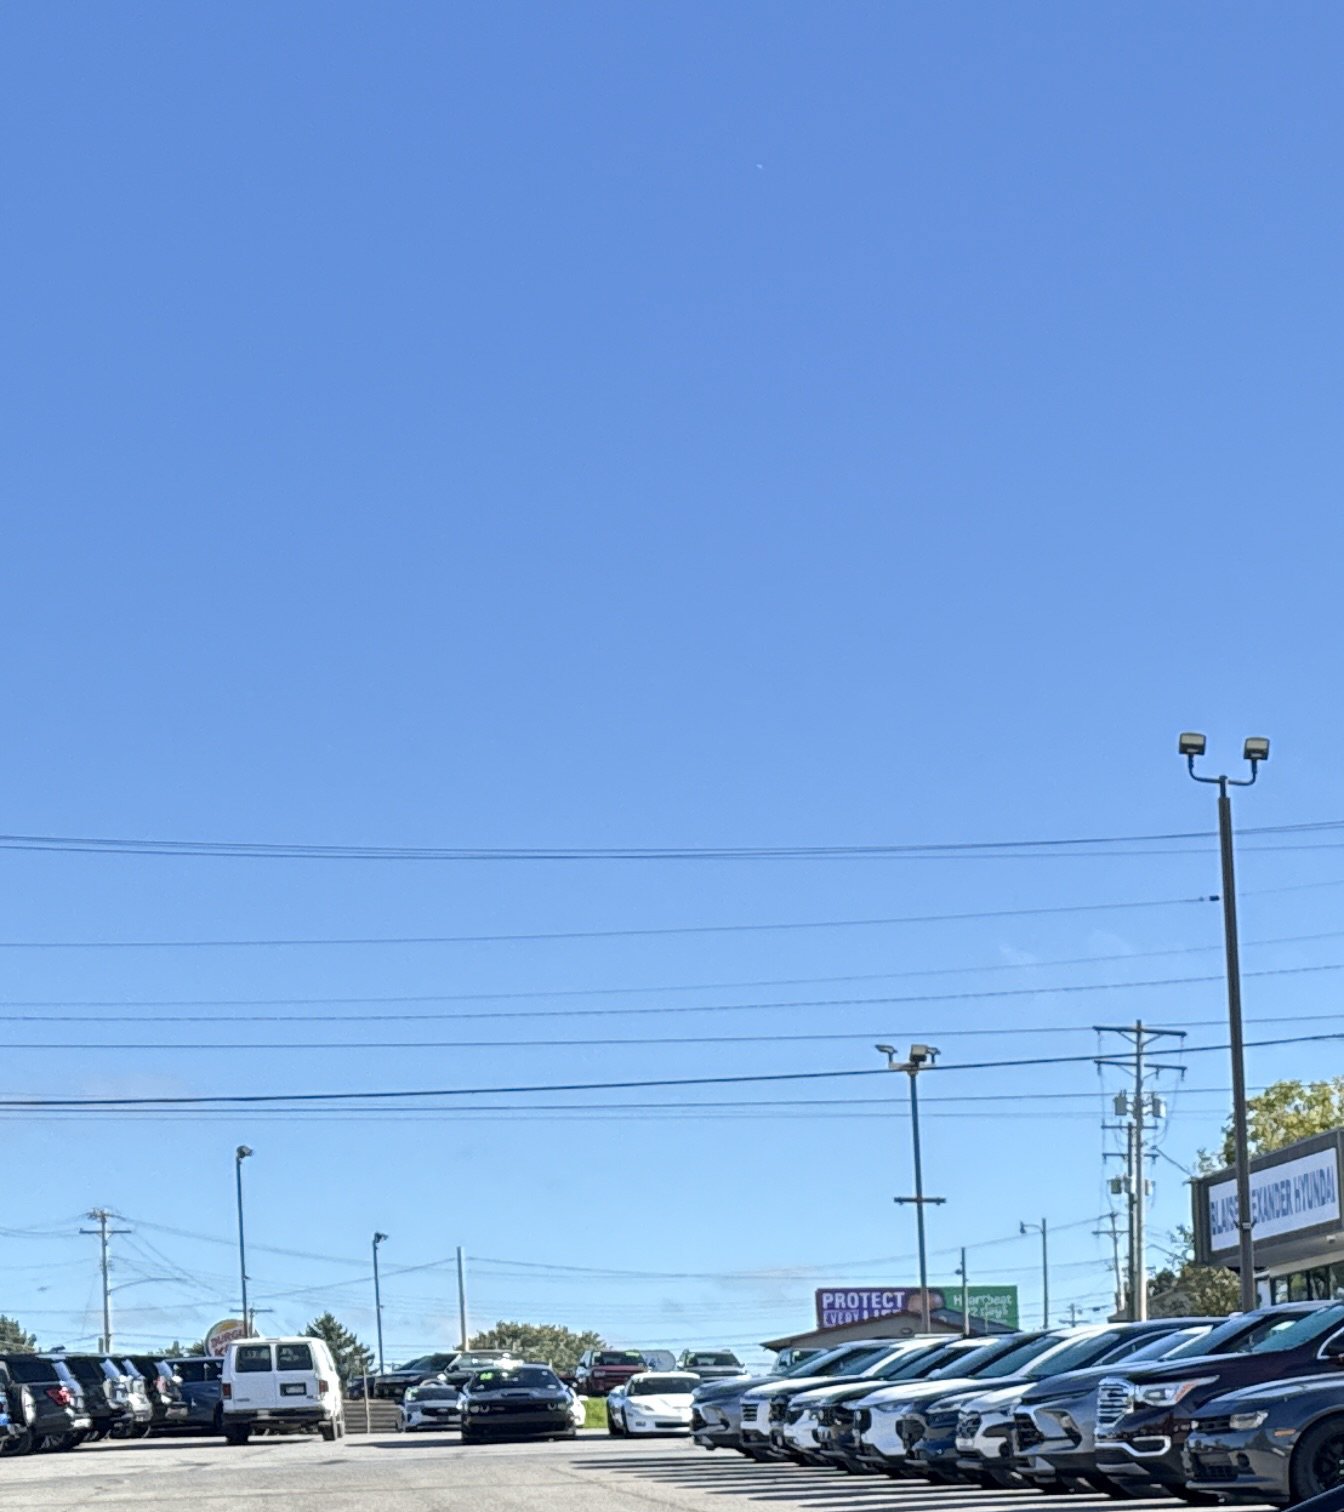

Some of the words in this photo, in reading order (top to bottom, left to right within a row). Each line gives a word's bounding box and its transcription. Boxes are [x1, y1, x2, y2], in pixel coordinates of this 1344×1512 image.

[1252, 1179, 1294, 1223] EXANDER
[1294, 1166, 1336, 1212] HYUNDAI
[821, 1291, 906, 1309] PROTECT
[953, 1294, 1012, 1307] Hartbeat
[822, 1309, 860, 1328] EVERY
